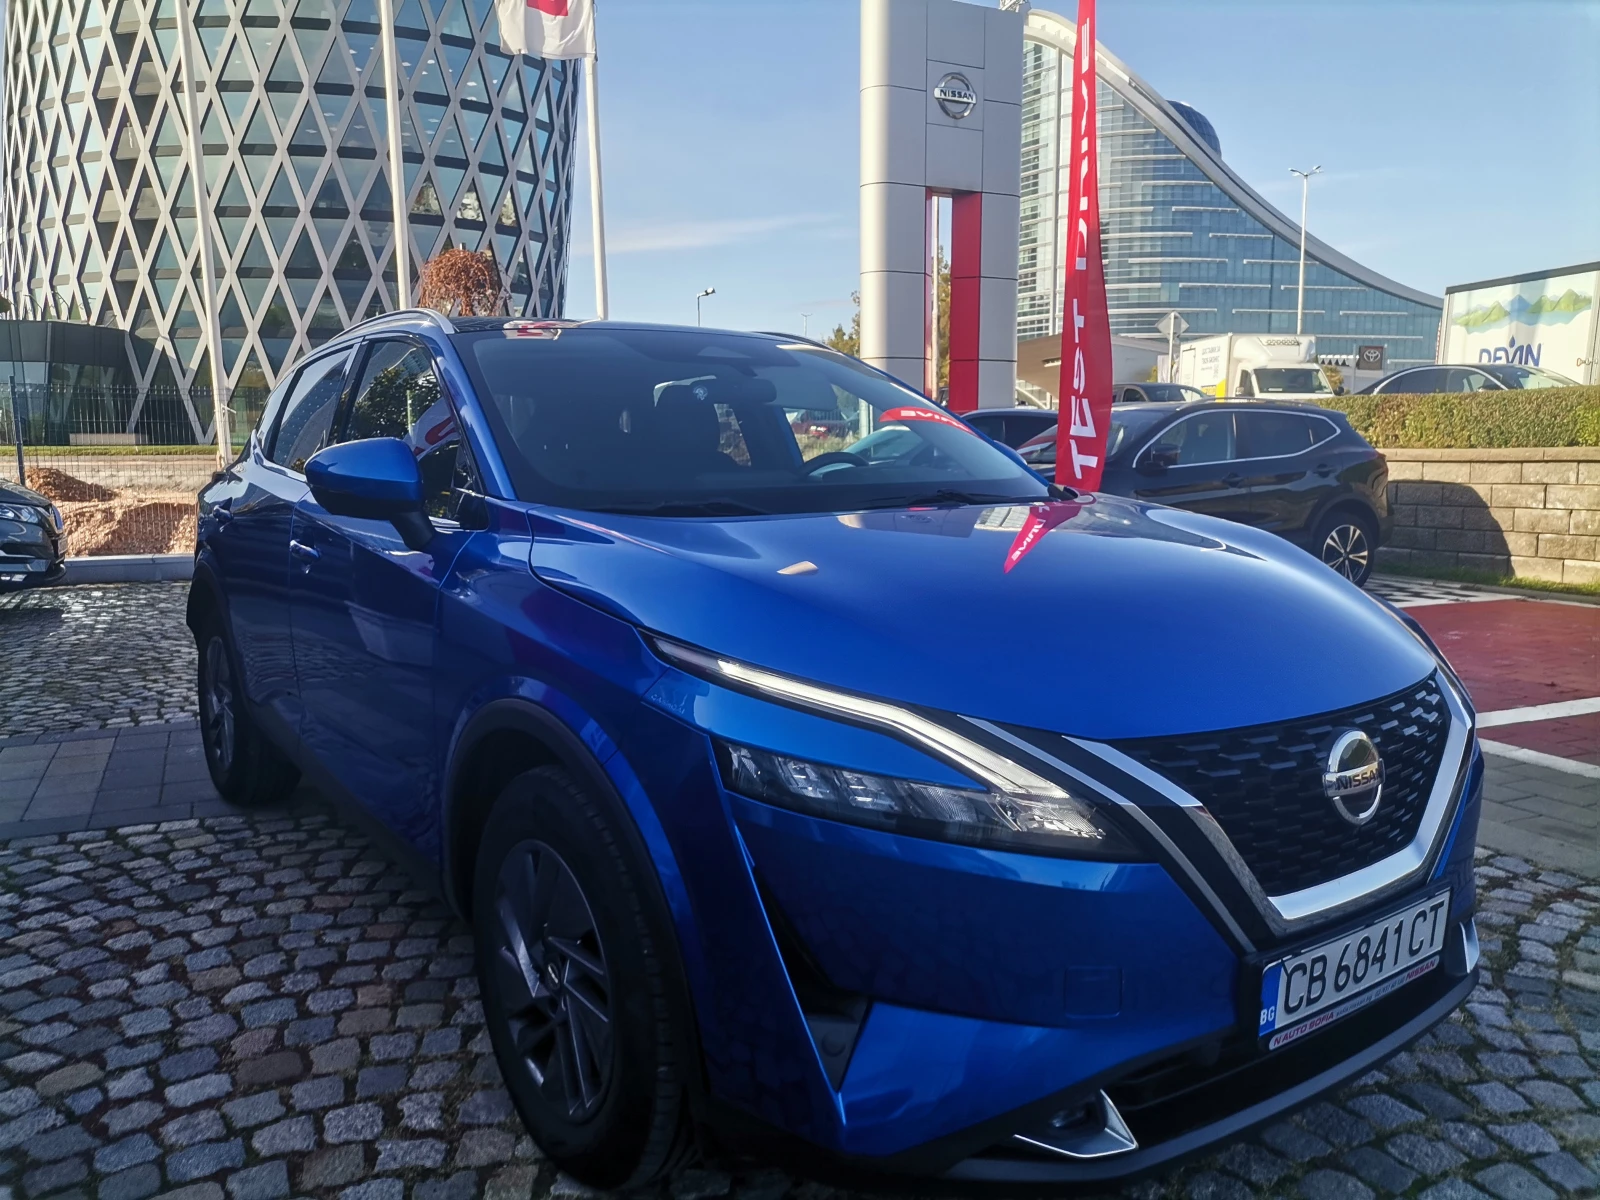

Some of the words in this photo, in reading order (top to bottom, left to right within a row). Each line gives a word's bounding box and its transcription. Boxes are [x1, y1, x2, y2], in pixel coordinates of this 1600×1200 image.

[939, 89, 974, 102] NISSAN
[1069, 298, 1098, 479] TEST
[1335, 766, 1382, 790] NISSAN
[1259, 1006, 1276, 1026] BG
